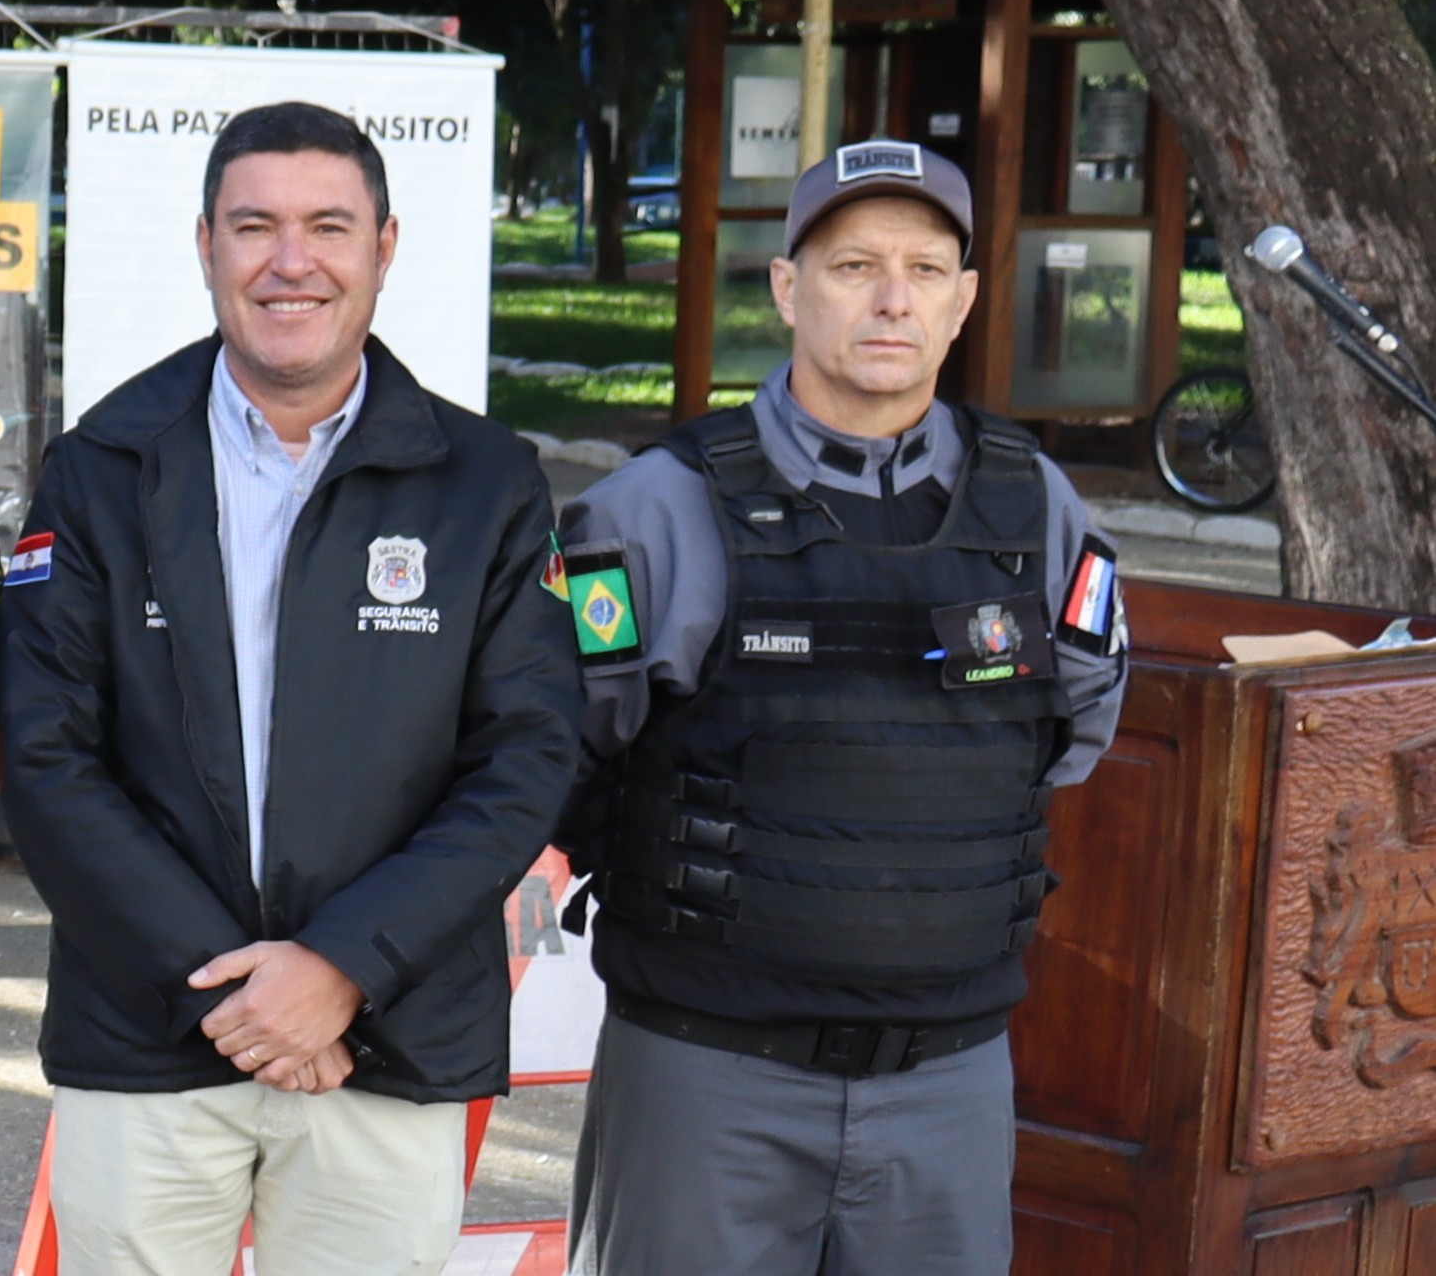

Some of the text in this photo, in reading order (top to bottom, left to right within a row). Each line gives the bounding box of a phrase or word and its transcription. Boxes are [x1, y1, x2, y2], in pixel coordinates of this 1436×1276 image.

[87, 105, 469, 143] PELA PAZ NSITO!
[357, 606, 440, 621] SEGURANÇA
[357, 617, 440, 634] E TRÂNSITO
[742, 630, 811, 654] TRÂNSITO
